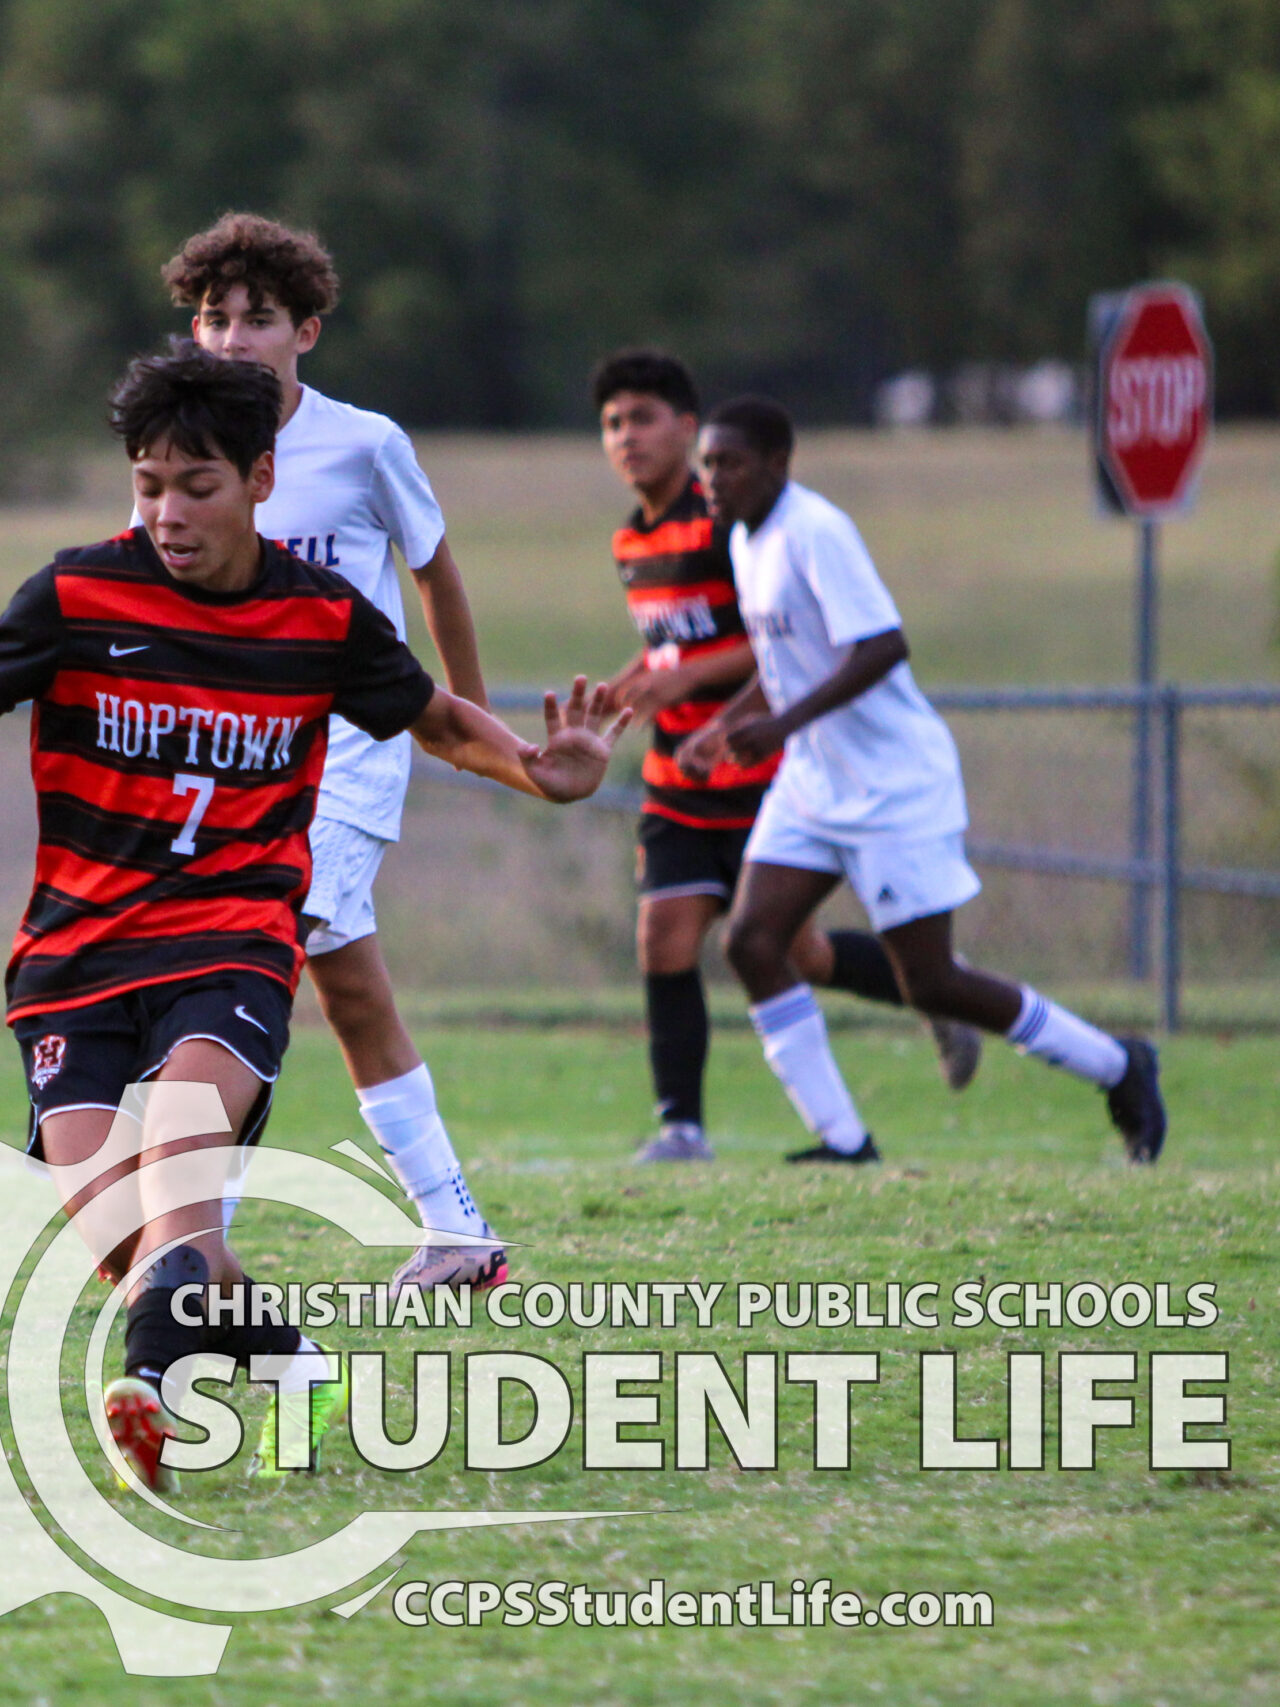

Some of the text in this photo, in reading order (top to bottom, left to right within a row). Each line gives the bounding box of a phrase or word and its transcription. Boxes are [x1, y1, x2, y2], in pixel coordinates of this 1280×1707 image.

[1109, 357, 1206, 447] STOP
[95, 691, 304, 770] HOPTOWN
[170, 773, 215, 856] 7
